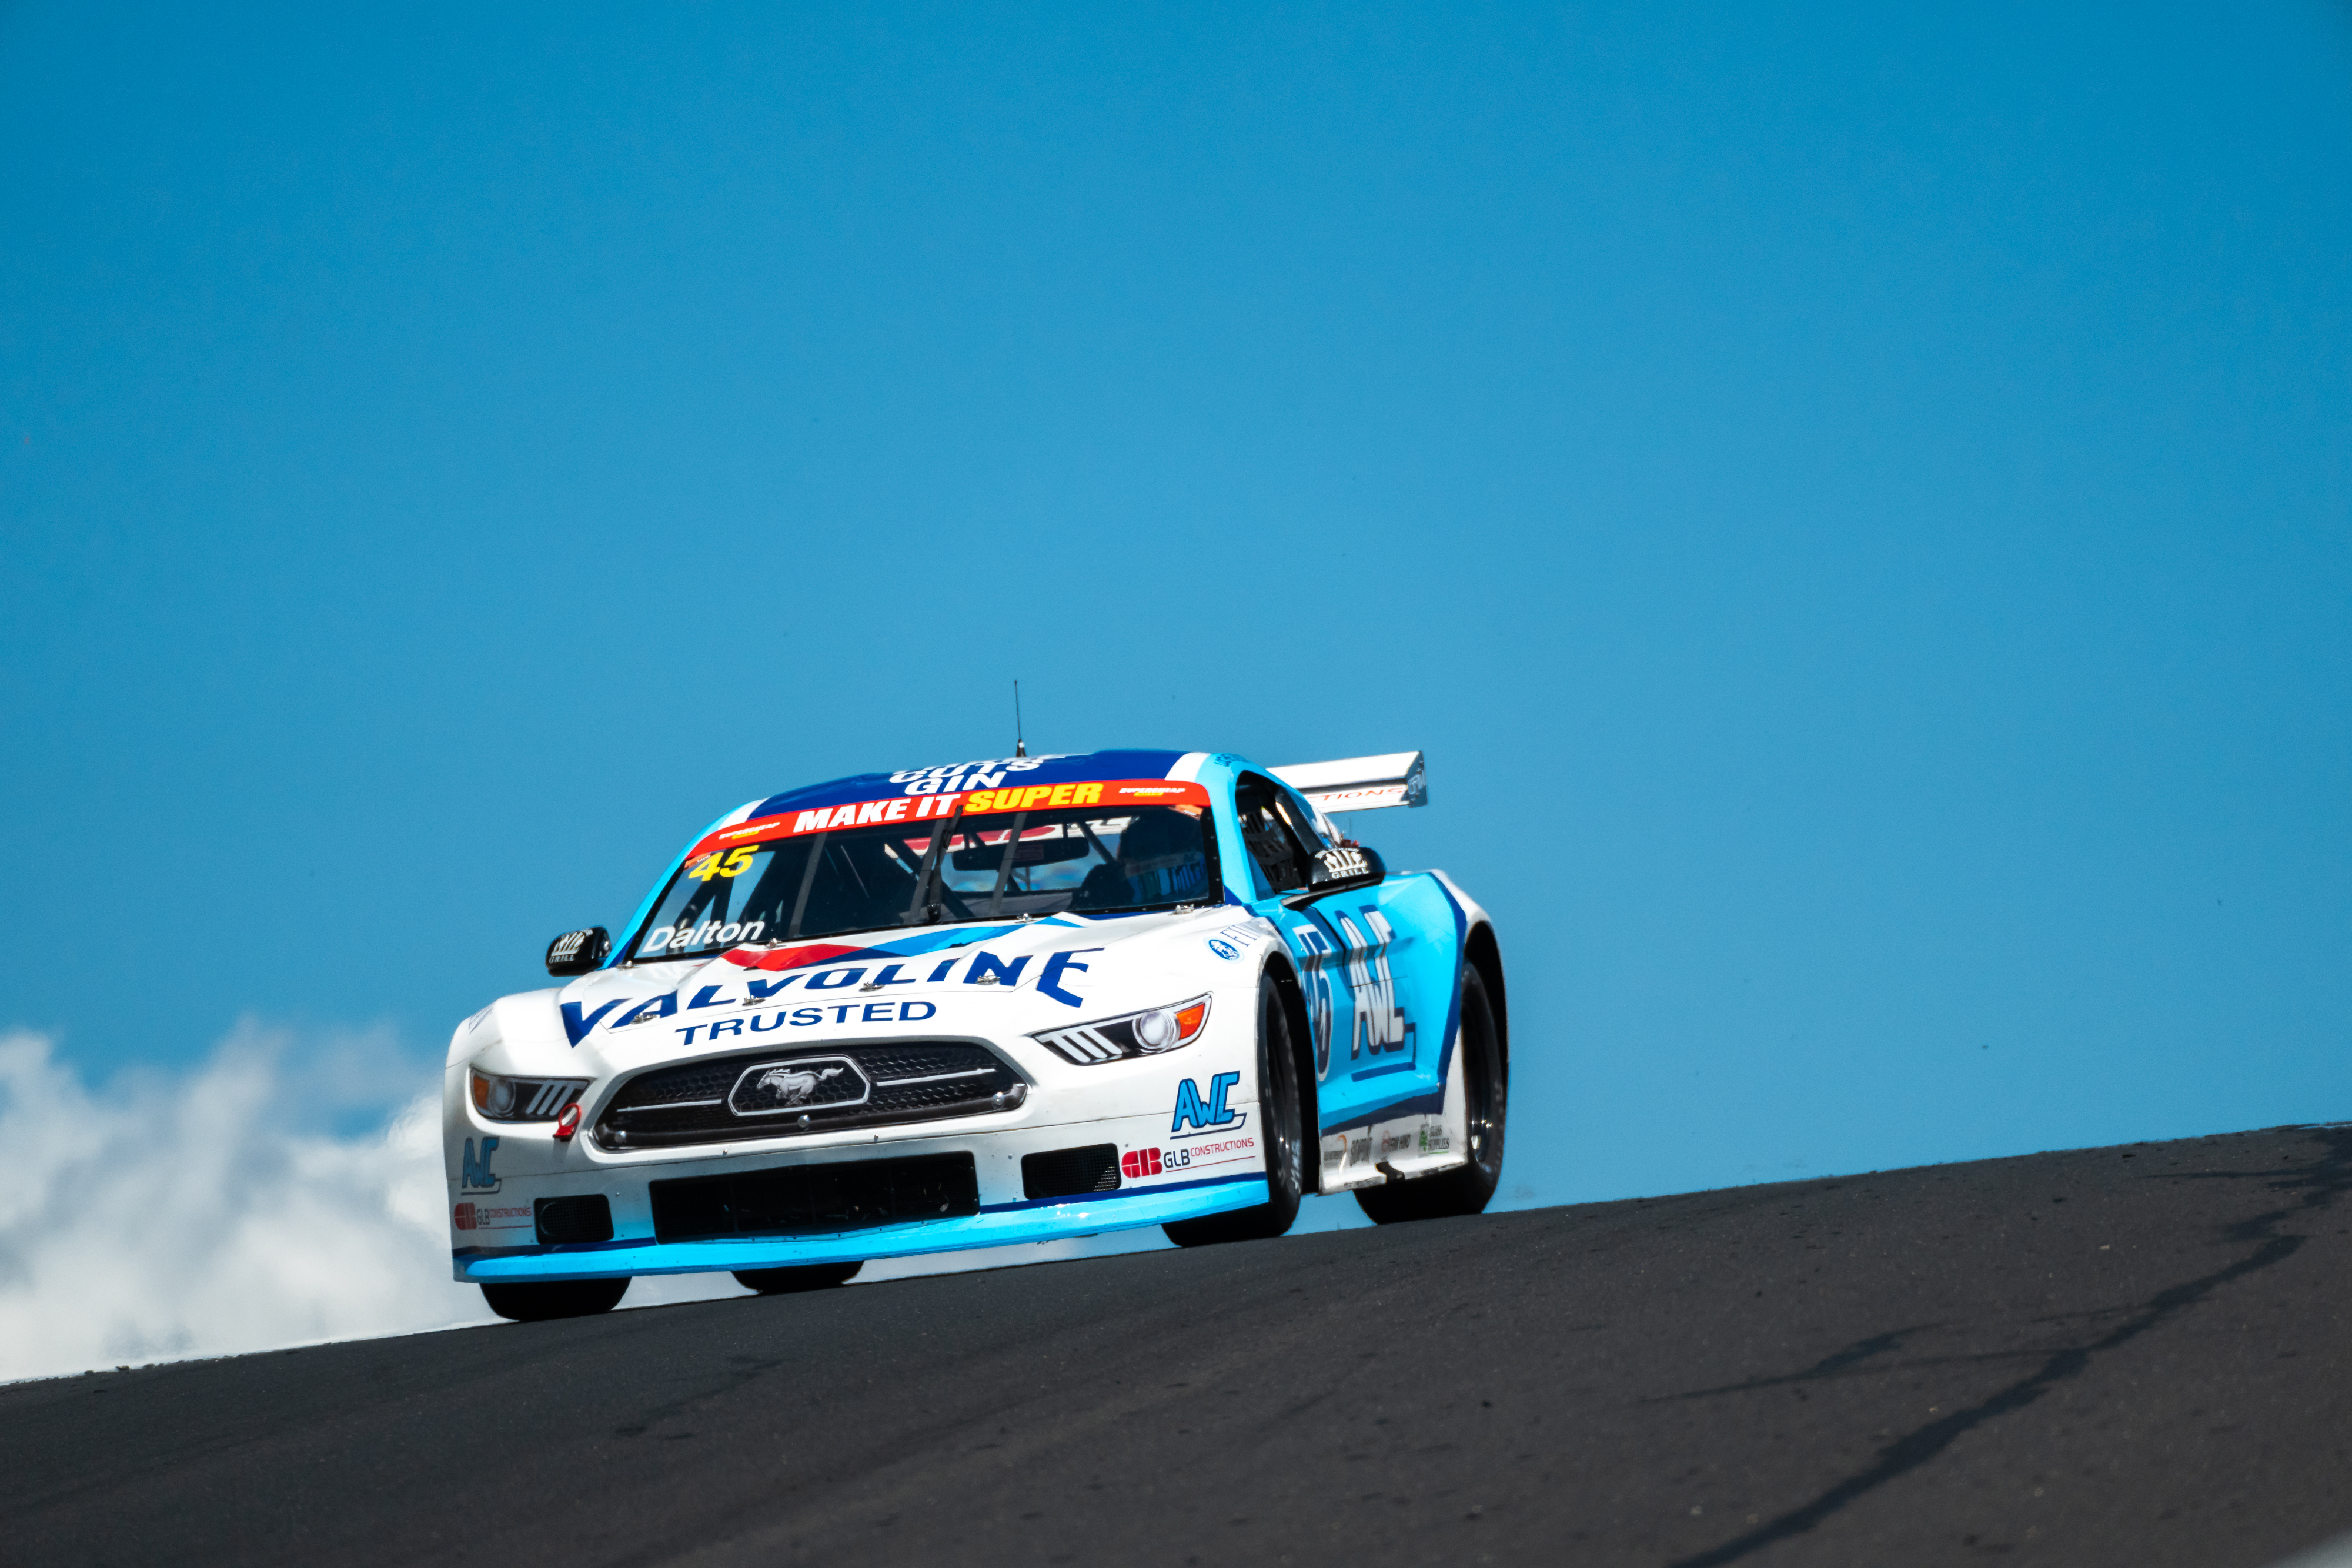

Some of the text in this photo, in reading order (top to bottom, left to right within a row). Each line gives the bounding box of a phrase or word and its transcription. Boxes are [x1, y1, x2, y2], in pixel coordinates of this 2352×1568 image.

[904, 771, 1007, 795] GIN
[793, 783, 1104, 833] MAKE IT SUPER
[718, 822, 780, 840] SUPERCHEAP
[688, 845, 759, 881] 45
[1331, 867, 1370, 879] GRILL
[642, 920, 766, 953] Dalton
[549, 954, 575, 964] GRILL
[560, 947, 1105, 1048] VALVOLINE
[675, 1001, 936, 1046] TRUSTED
[1171, 1070, 1240, 1132] AWC
[462, 1137, 499, 1188] AWC
[1164, 1149, 1190, 1168] GLB
[1191, 1138, 1254, 1157] CONSTRUCTIONS
[477, 1208, 490, 1225] GLB
[490, 1207, 532, 1218] CONSTRUCTIONS
